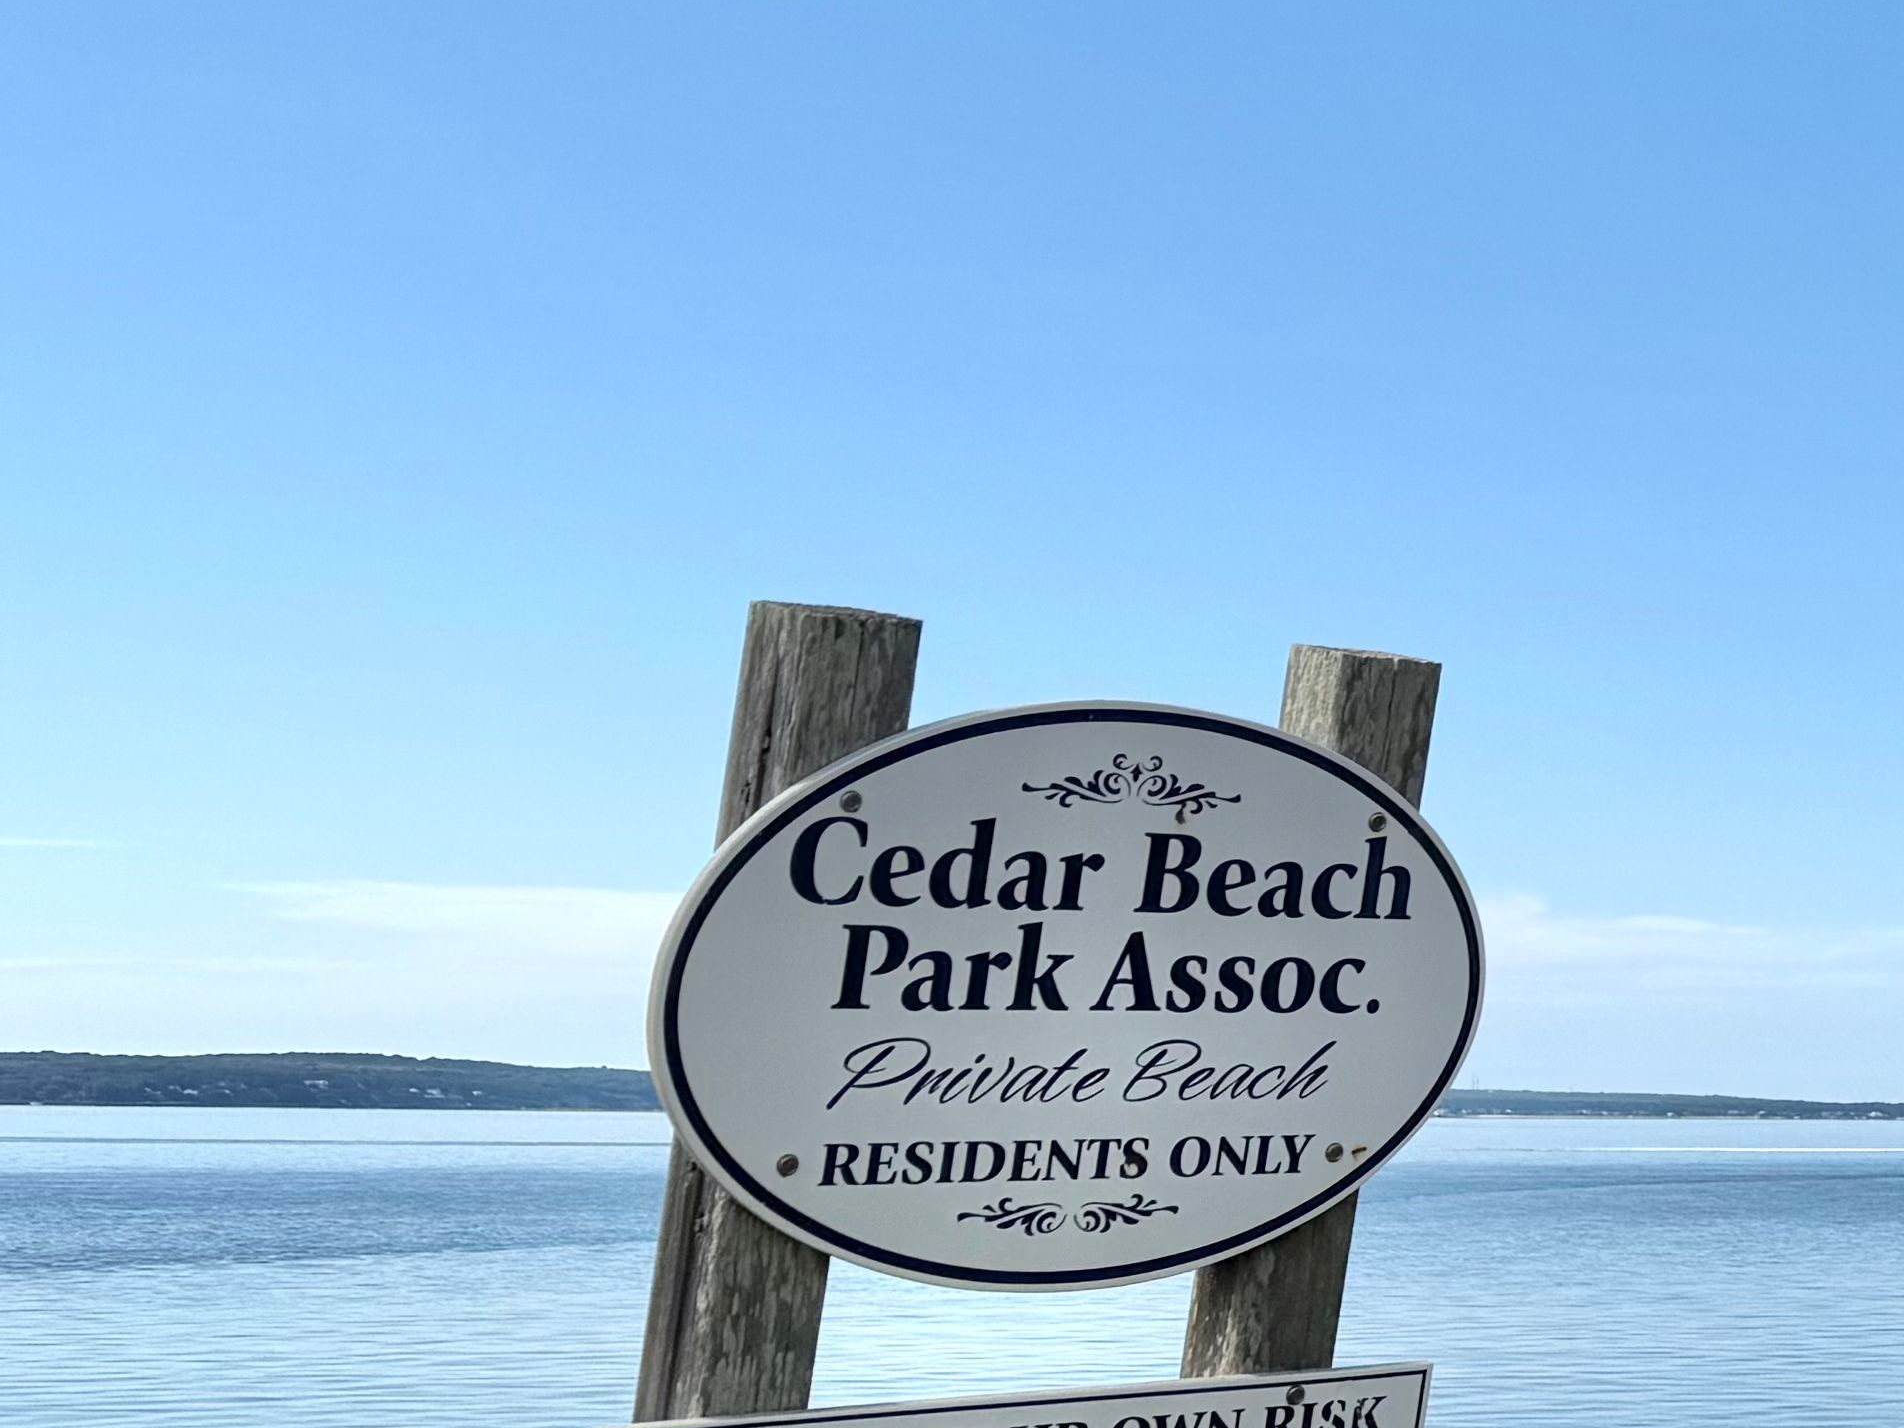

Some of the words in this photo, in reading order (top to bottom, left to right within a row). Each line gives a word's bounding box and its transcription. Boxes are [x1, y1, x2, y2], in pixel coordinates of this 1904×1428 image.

[789, 816, 1106, 912] Cedar
[1133, 832, 1412, 921] Beach
[830, 921, 1074, 1012] Park
[1089, 931, 1381, 1015] Assoc.
[825, 1036, 1107, 1111] Private
[1122, 1038, 1337, 1103] Beach
[817, 1136, 1150, 1187] RESIDENTS
[1169, 1133, 1317, 1178] ONLY
